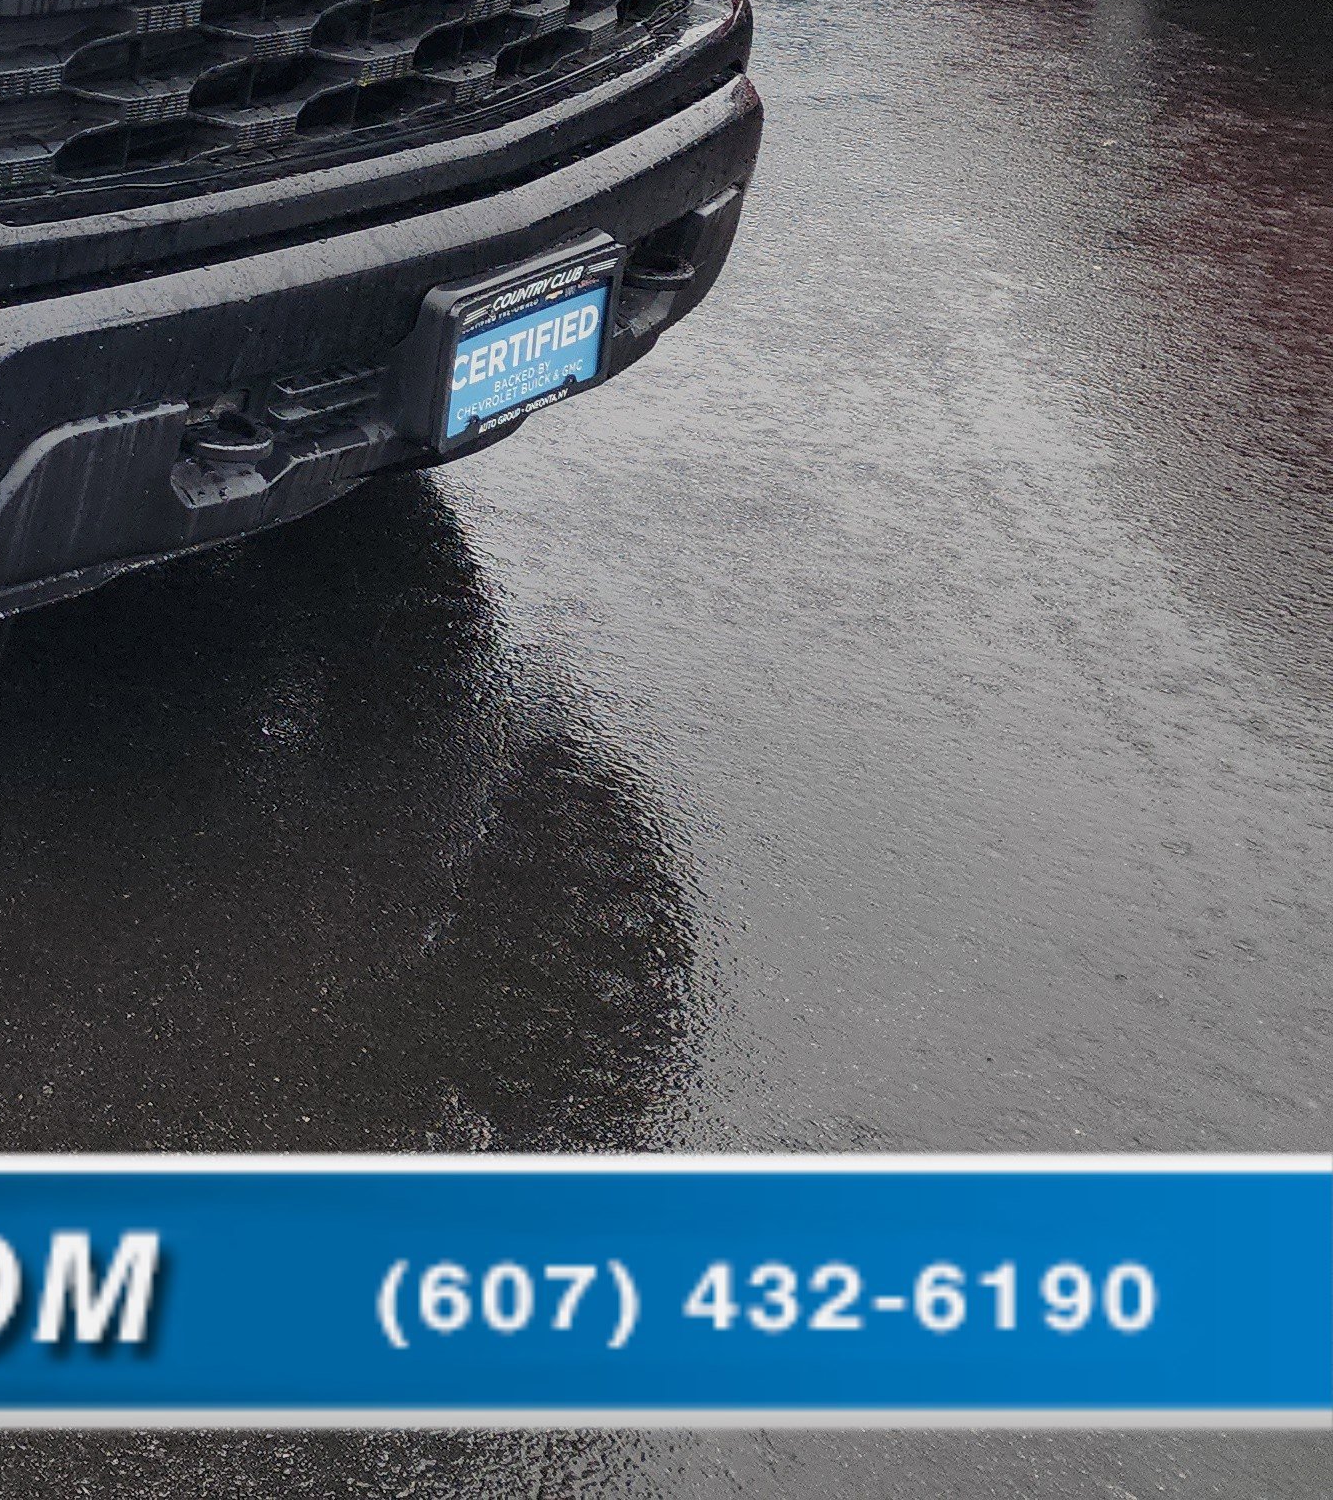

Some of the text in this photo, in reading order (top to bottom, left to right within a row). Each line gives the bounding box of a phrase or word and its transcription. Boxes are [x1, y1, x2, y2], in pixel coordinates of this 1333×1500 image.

[491, 276, 553, 311] COUNTRY
[550, 265, 585, 289] CLUB
[452, 304, 601, 392] CERTIFIED
[456, 386, 518, 421] CHEVROLET
[521, 374, 551, 395] BUICK
[561, 359, 584, 377] GMC
[494, 361, 551, 393] BACKED BY
